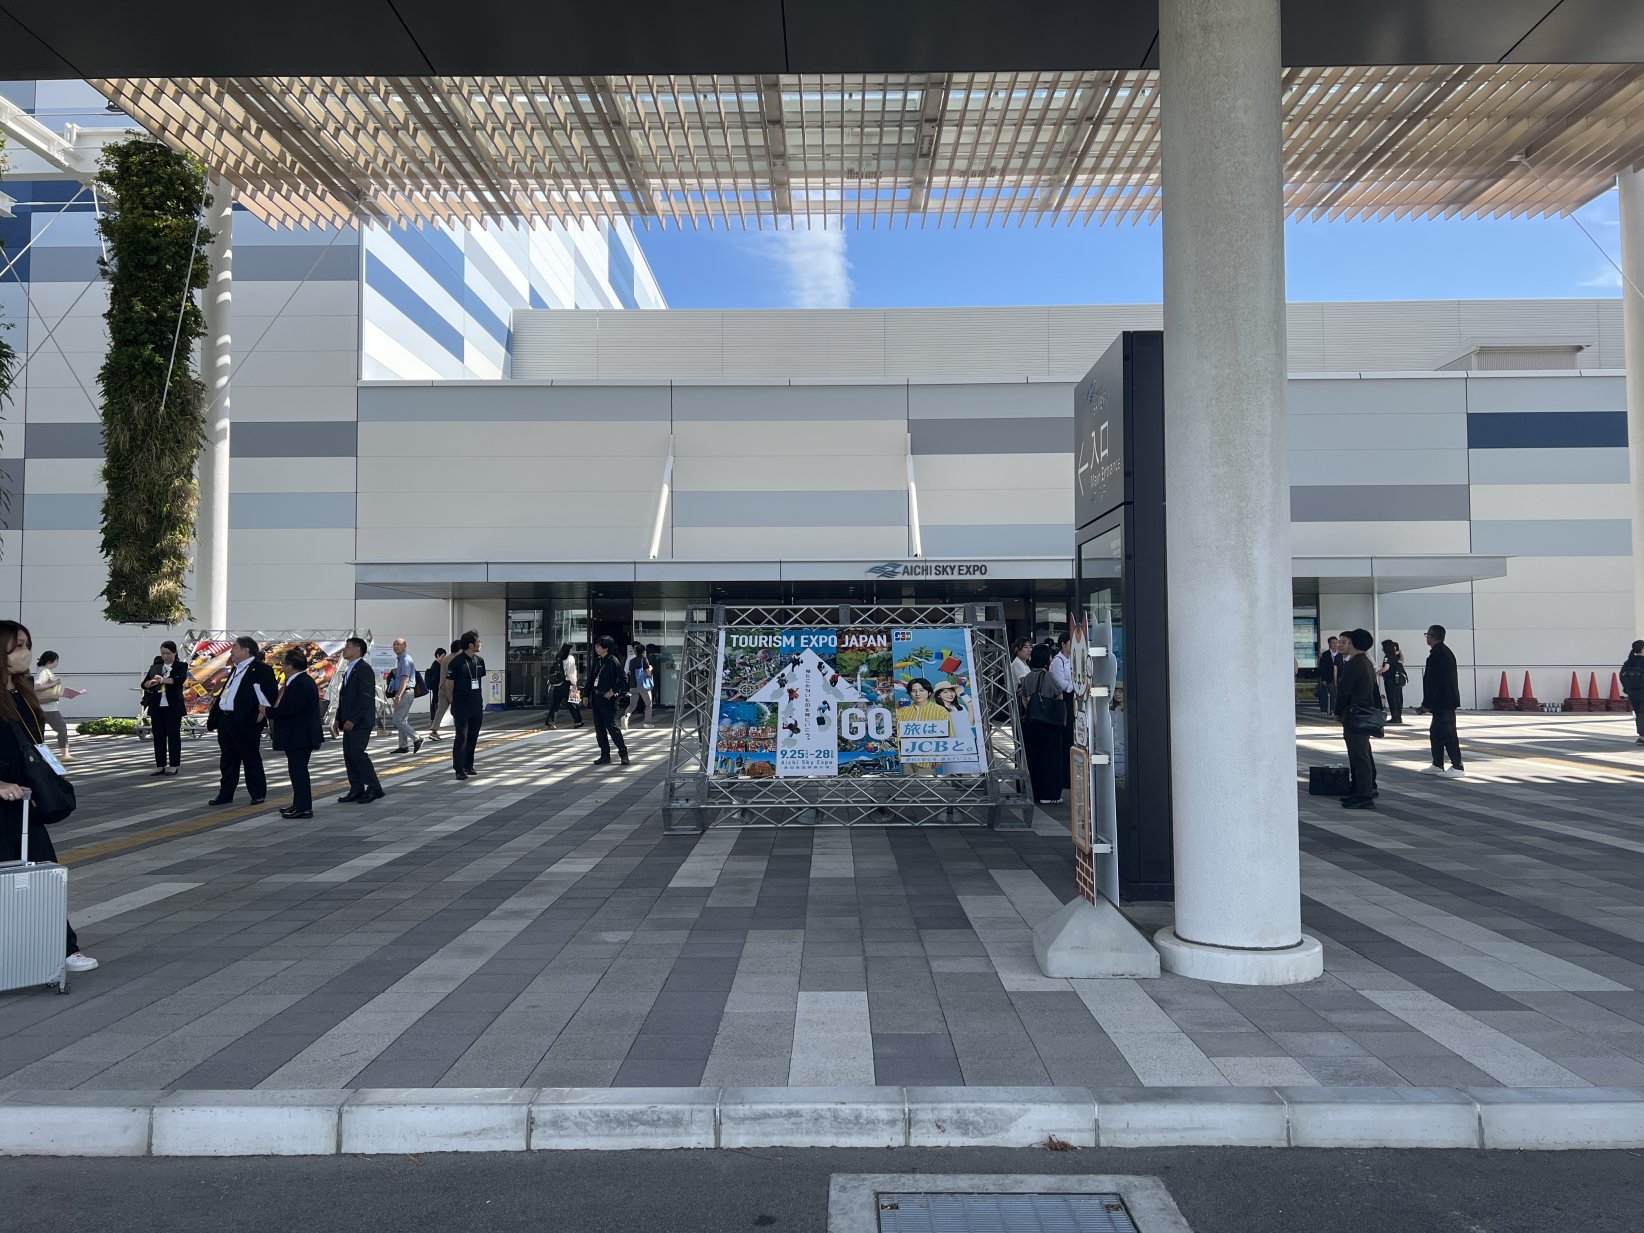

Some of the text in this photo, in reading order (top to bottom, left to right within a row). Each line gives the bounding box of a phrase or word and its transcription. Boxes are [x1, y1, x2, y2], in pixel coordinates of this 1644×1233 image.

[1090, 420, 1109, 470] 入口
[902, 564, 988, 576] AICHI SKY EXPO
[730, 634, 887, 648] TOURISM EXPO JAPAN
[841, 707, 893, 741] GO
[904, 722, 945, 736] 旅は、
[905, 740, 973, 753] JCBと。
[780, 749, 805, 759] 9.25
